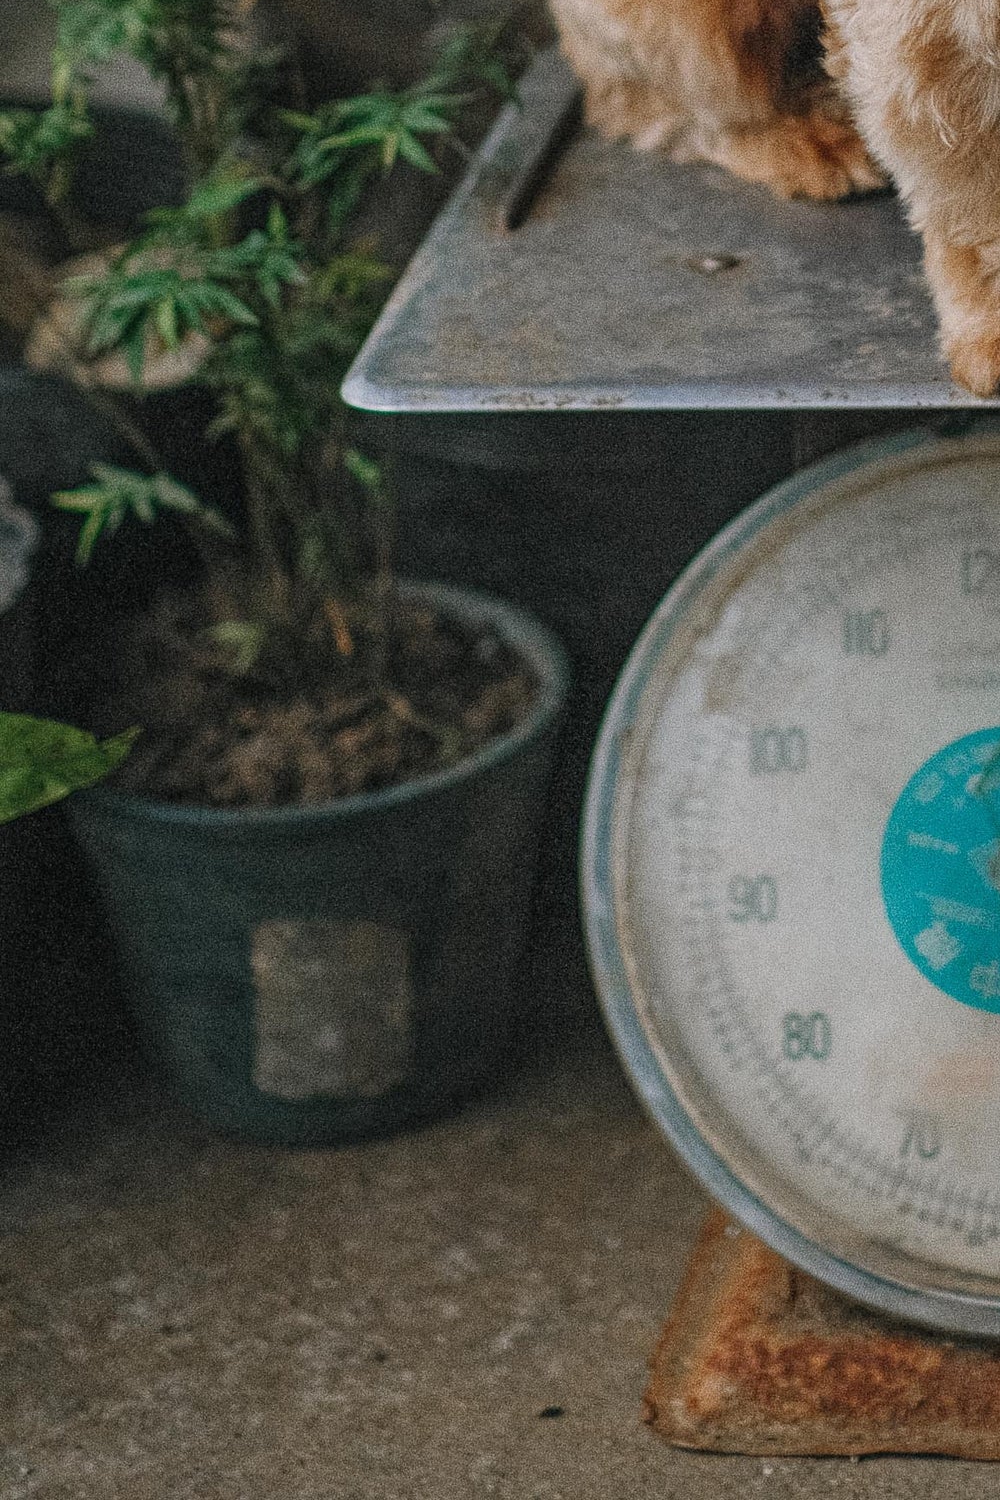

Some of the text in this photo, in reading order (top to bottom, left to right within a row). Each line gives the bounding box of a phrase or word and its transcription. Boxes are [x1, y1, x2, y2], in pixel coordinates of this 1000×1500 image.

[842, 608, 890, 657] 110
[749, 723, 810, 776] 100
[728, 873, 779, 925] 90
[781, 1010, 833, 1062] 80
[896, 1109, 943, 1162] 70
